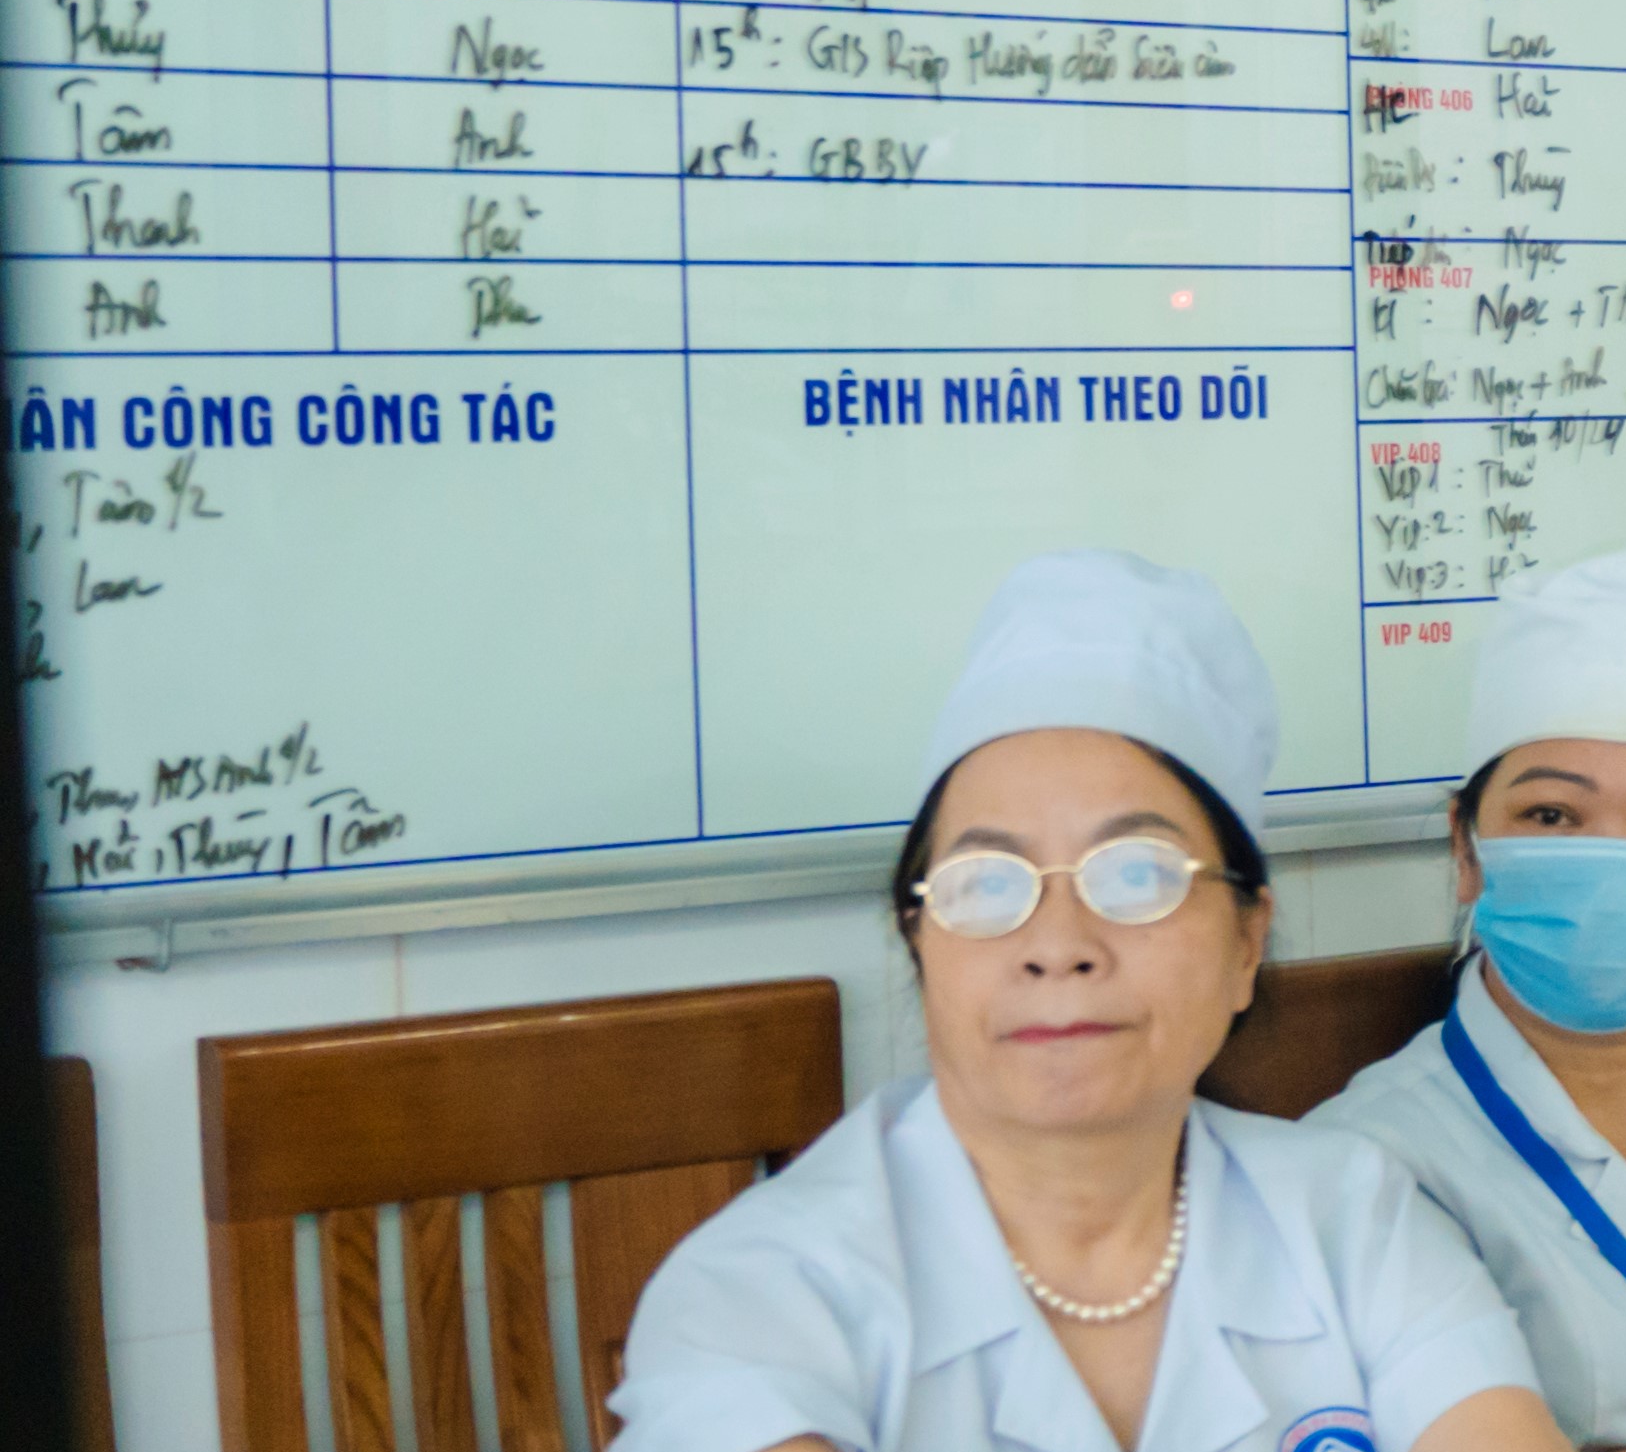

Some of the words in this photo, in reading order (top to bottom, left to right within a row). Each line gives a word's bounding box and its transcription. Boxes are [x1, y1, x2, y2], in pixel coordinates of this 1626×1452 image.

[1440, 89, 1473, 111] 406
[1440, 266, 1473, 290] 407
[805, 369, 923, 436] BỆNH
[943, 365, 1061, 425] NHÂN
[1078, 375, 1182, 422] THEO
[1201, 364, 1268, 423] DÕI
[123, 386, 272, 449] CÔNG
[298, 384, 440, 446] CÔNG
[462, 383, 556, 445] TÁC
[1371, 442, 1401, 465] VIP
[1406, 442, 1441, 464] 408
[1381, 623, 1412, 646] VIP
[1418, 621, 1452, 643] 409
